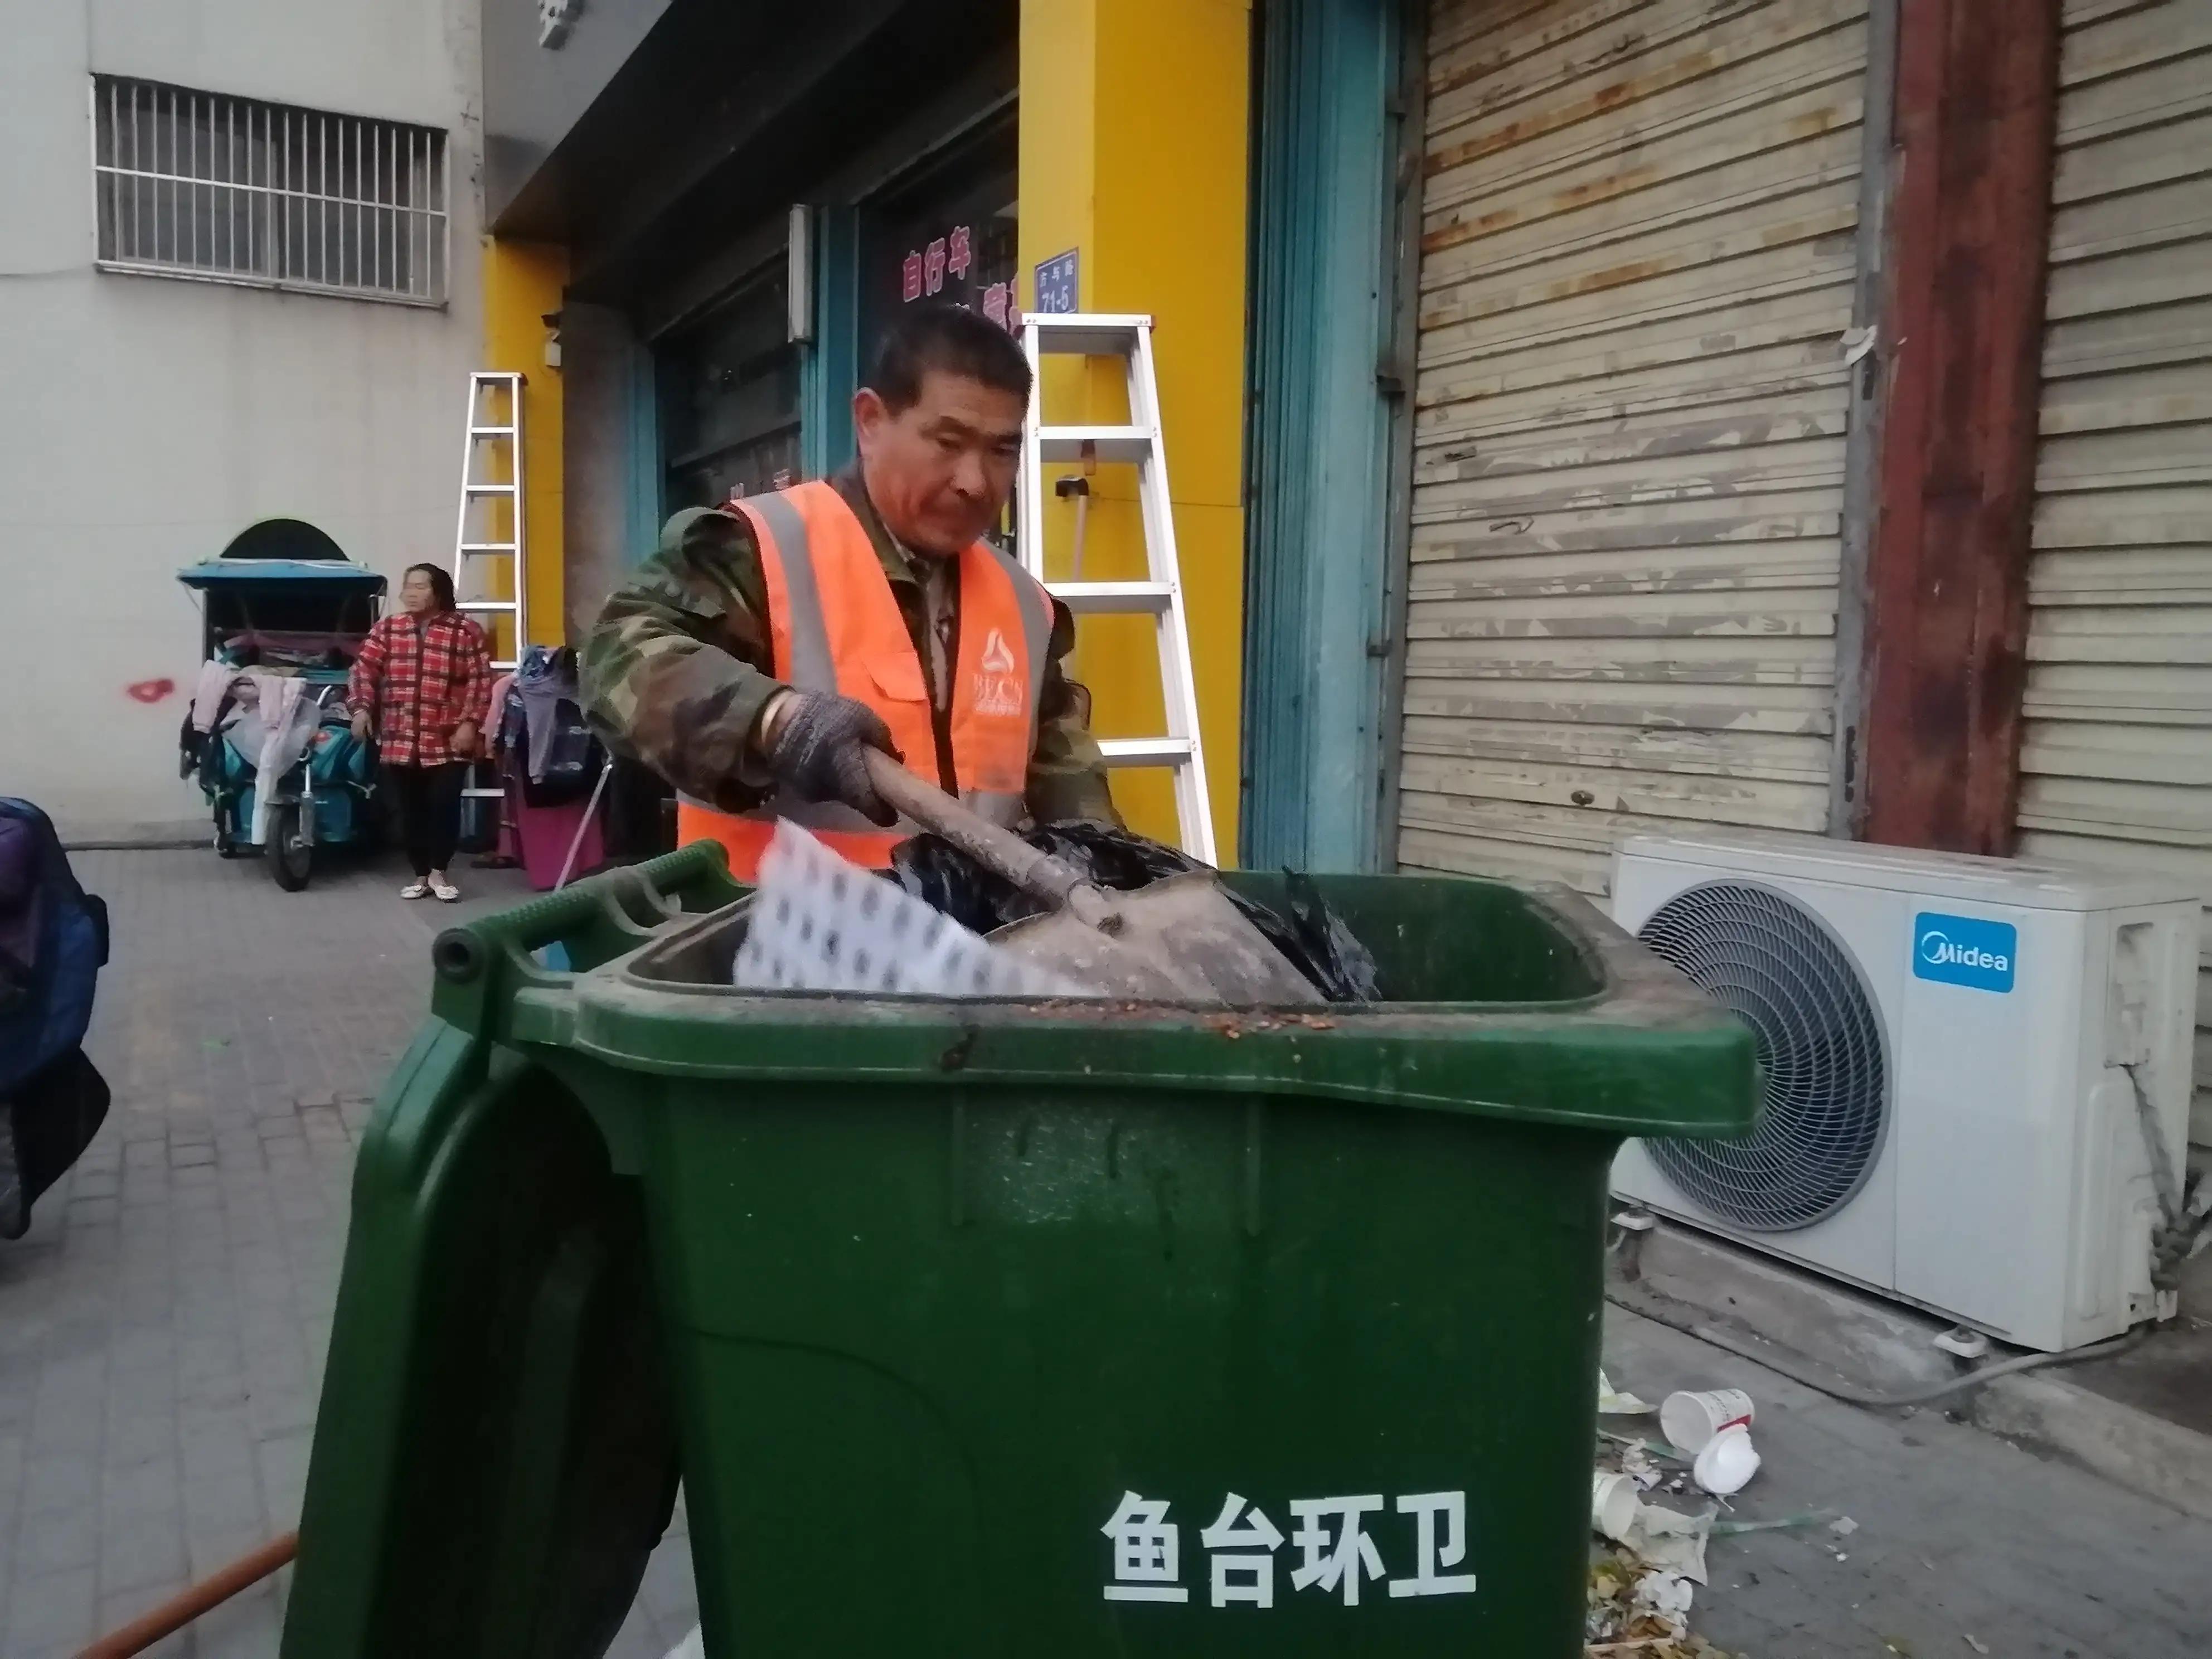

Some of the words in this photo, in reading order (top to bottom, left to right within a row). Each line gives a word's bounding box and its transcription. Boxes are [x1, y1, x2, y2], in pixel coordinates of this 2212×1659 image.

[903, 225, 971, 303] 自行车
[1922, 930, 2008, 971] Midea
[1099, 1490, 1477, 1609] 鱼台环卫
